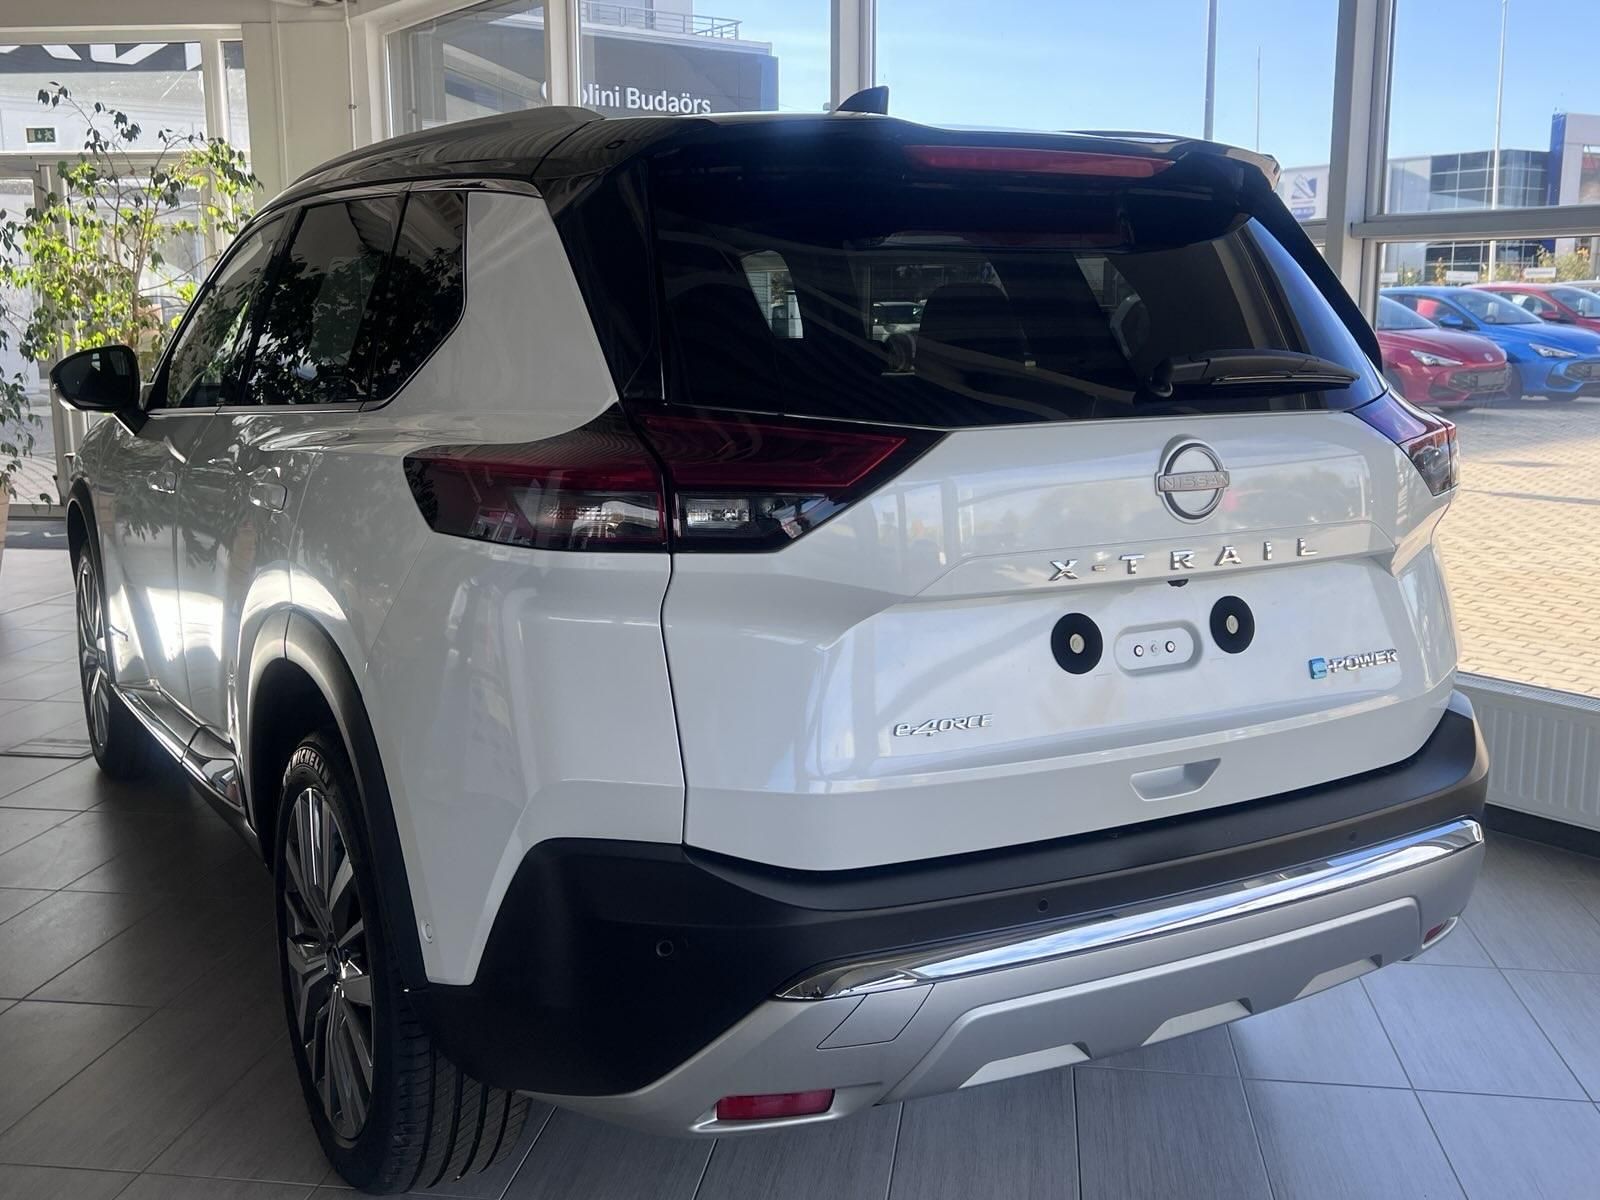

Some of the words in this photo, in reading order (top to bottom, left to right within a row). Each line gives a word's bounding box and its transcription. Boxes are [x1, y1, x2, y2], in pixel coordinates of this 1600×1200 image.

[626, 87, 712, 114] Budaörs
[1163, 473, 1228, 490] NISSAN
[1049, 538, 1318, 581] X-TRAIL
[291, 748, 329, 784] MICHELIN
